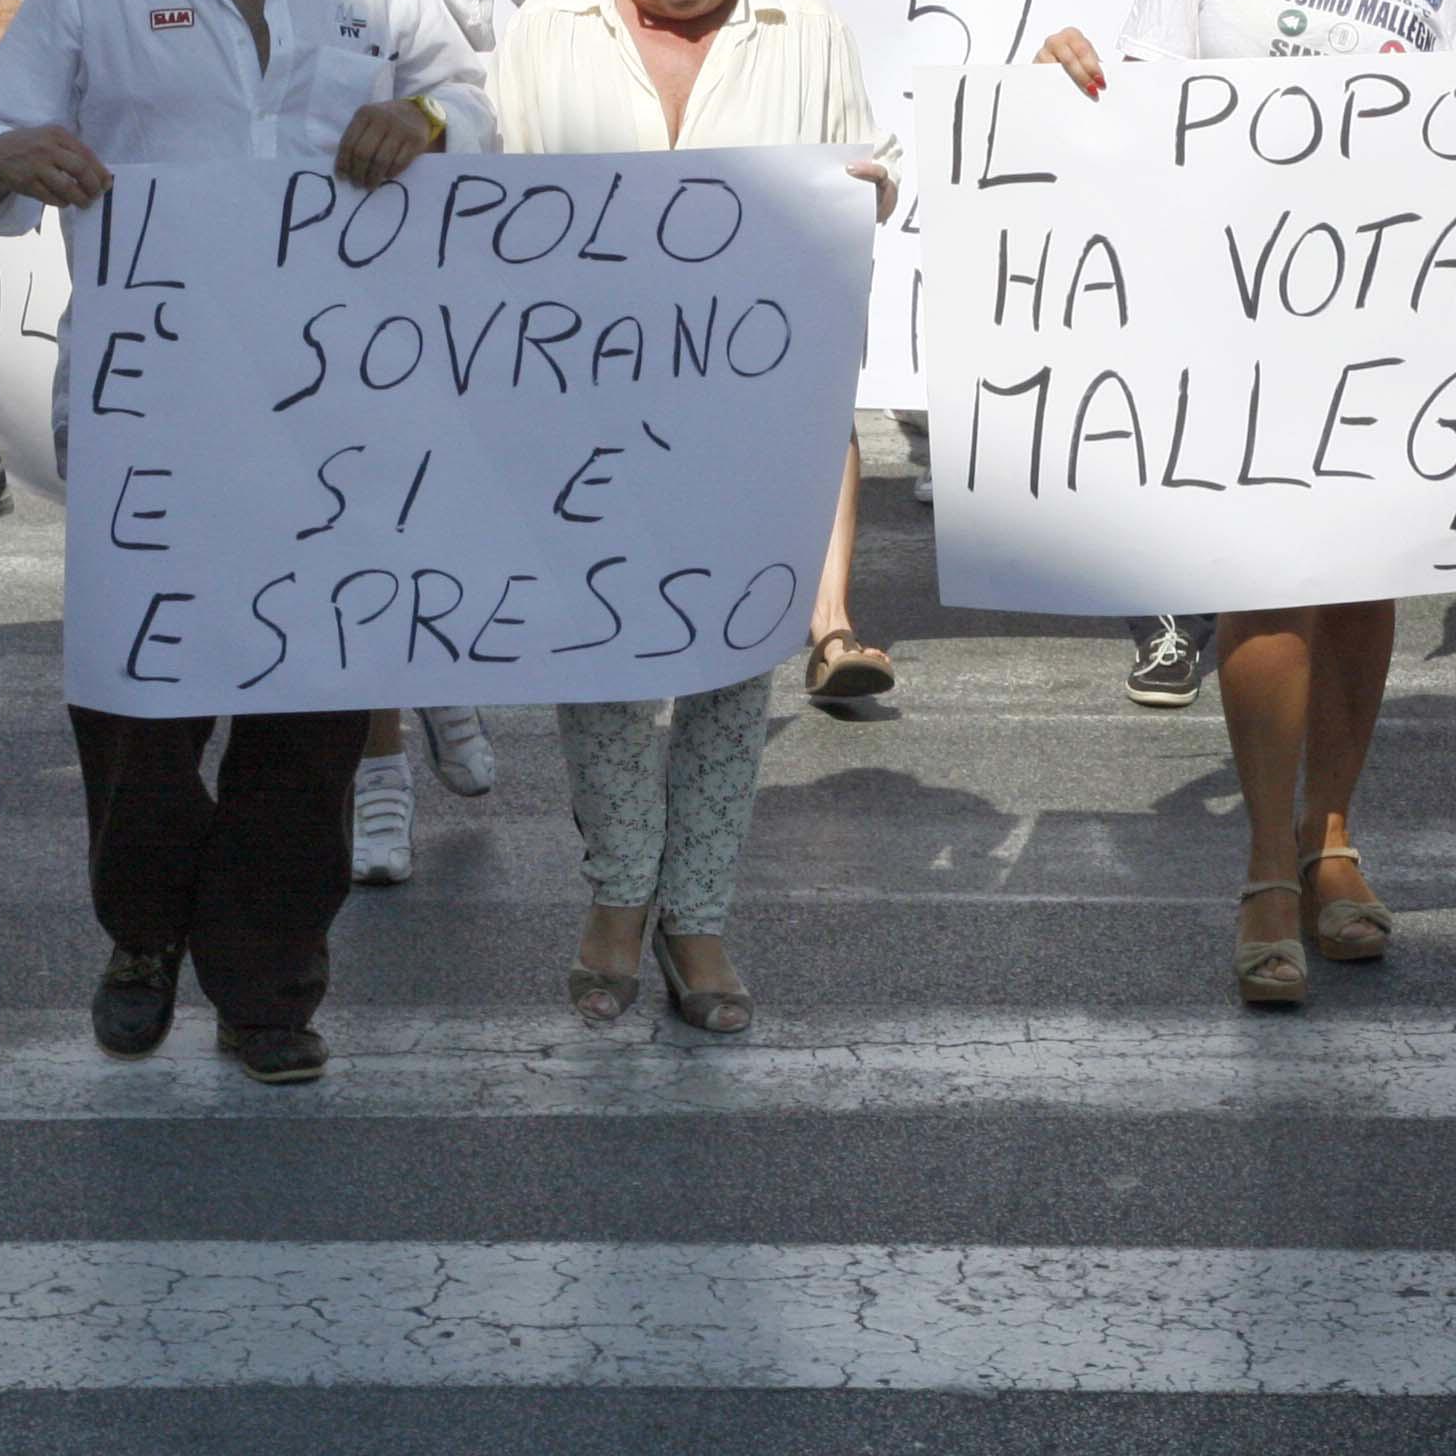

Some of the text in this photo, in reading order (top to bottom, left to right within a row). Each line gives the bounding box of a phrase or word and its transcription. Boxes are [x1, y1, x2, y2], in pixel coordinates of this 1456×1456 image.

[951, 75, 1057, 190] IL
[97, 169, 743, 289] IL POPOLO
[994, 228, 1128, 331] HA
[272, 295, 793, 413] SOVRANO
[112, 467, 173, 550] E
[296, 445, 433, 541] SI
[126, 555, 798, 690] ESPRESSO
